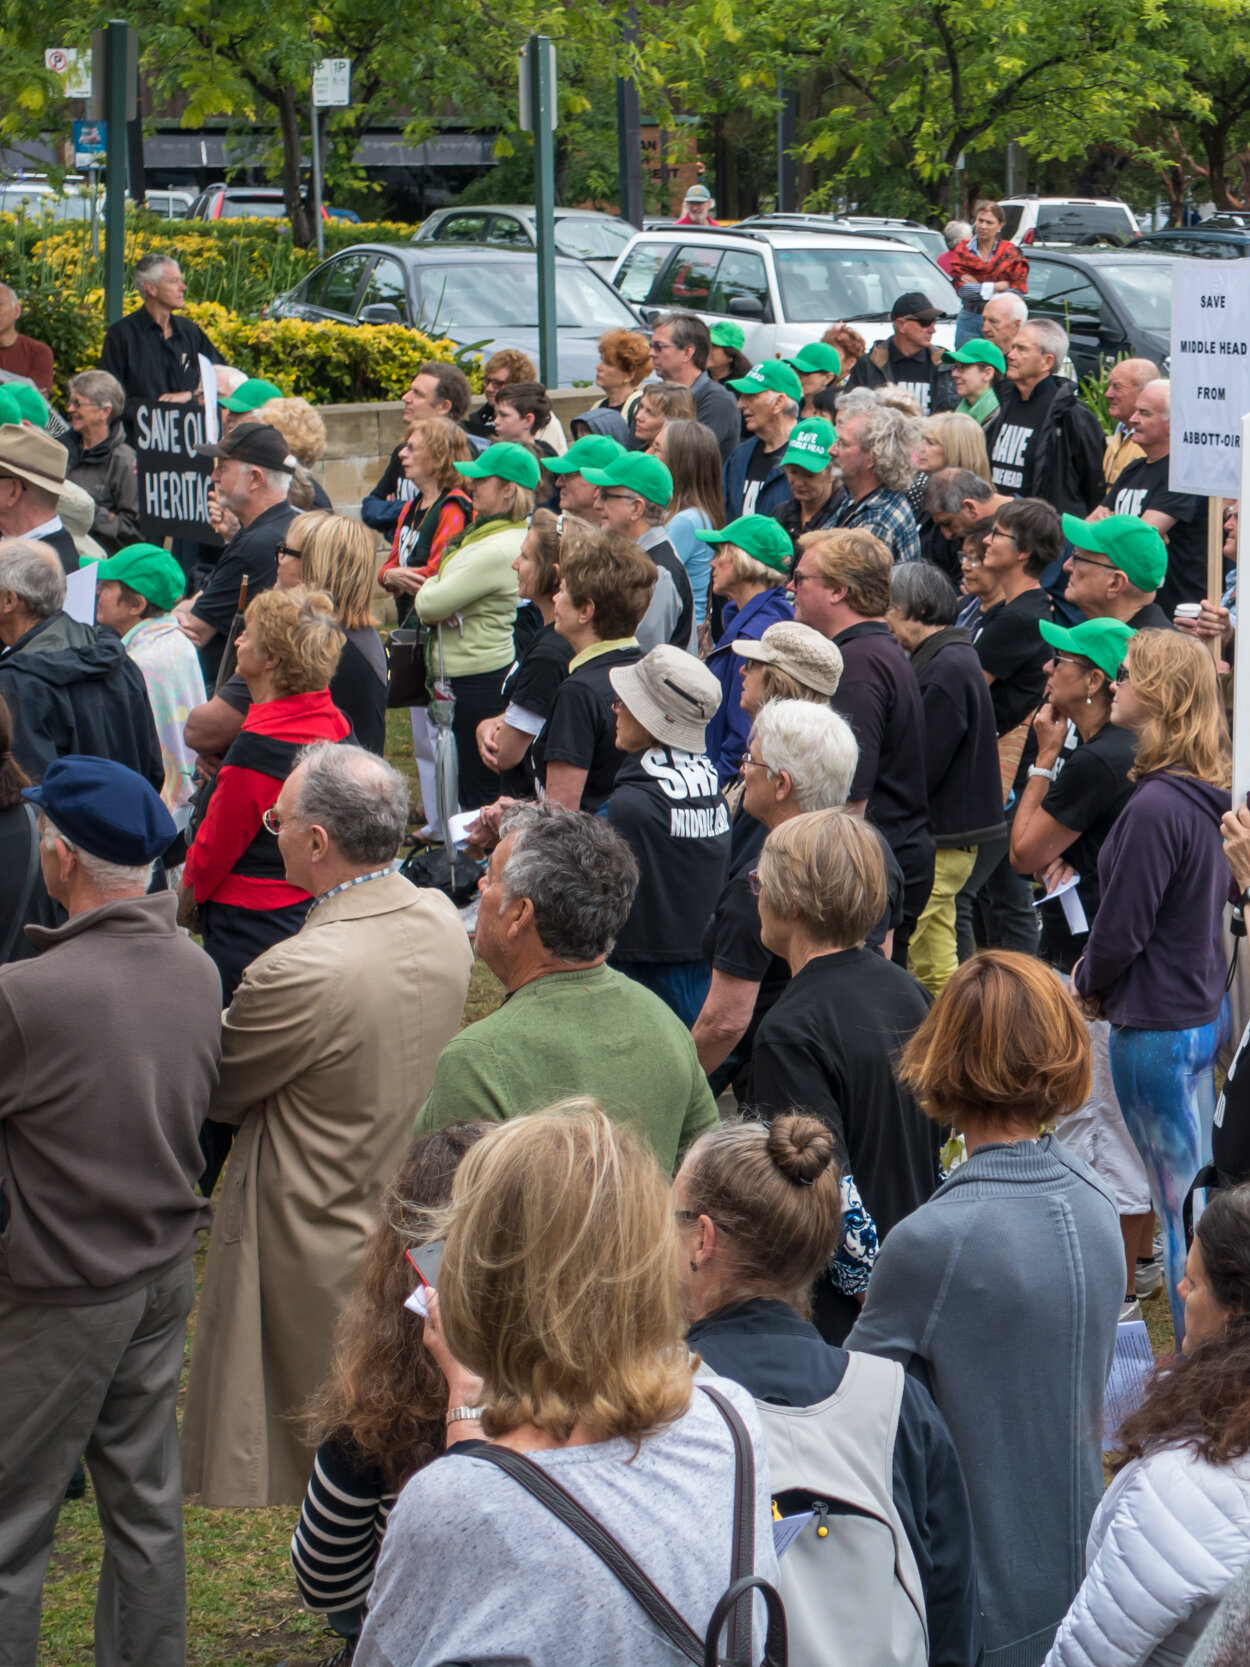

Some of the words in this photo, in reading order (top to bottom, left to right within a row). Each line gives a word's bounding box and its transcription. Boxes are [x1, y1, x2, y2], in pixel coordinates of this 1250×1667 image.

[1200, 296, 1226, 308] SAVE
[1180, 340, 1216, 354] MIDDLE
[1219, 342, 1247, 355] HEAD
[1197, 387, 1226, 400] FROM
[137, 405, 180, 454] SAVE
[797, 431, 818, 444] SAVE
[808, 444, 825, 454] HEAD
